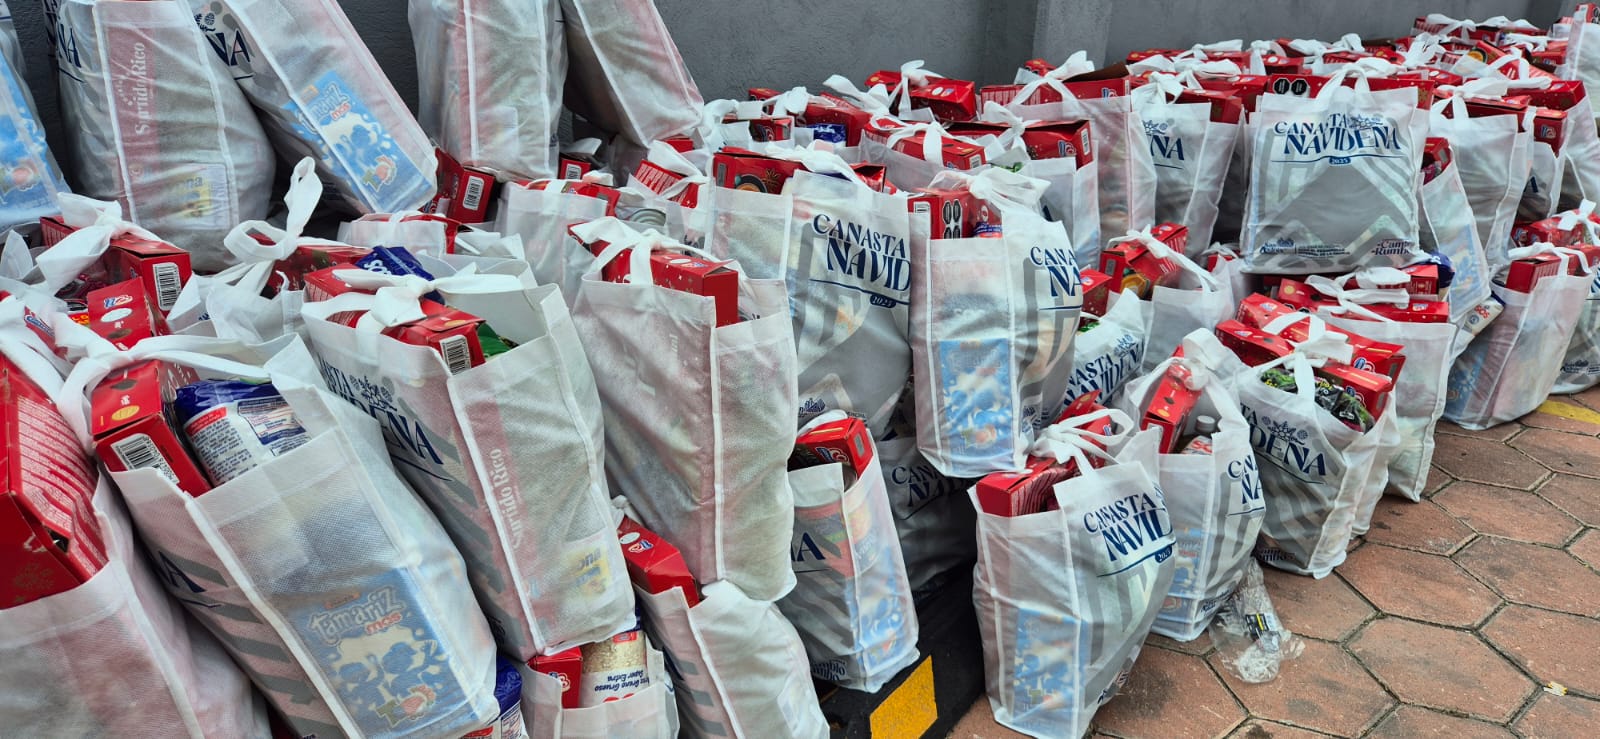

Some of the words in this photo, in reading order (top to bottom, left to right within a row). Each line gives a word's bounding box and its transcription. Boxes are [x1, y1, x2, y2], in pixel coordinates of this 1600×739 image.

[813, 213, 907, 259] CANASTA
[826, 237, 911, 292] NAVID
[607, 673, 627, 684] Extra
